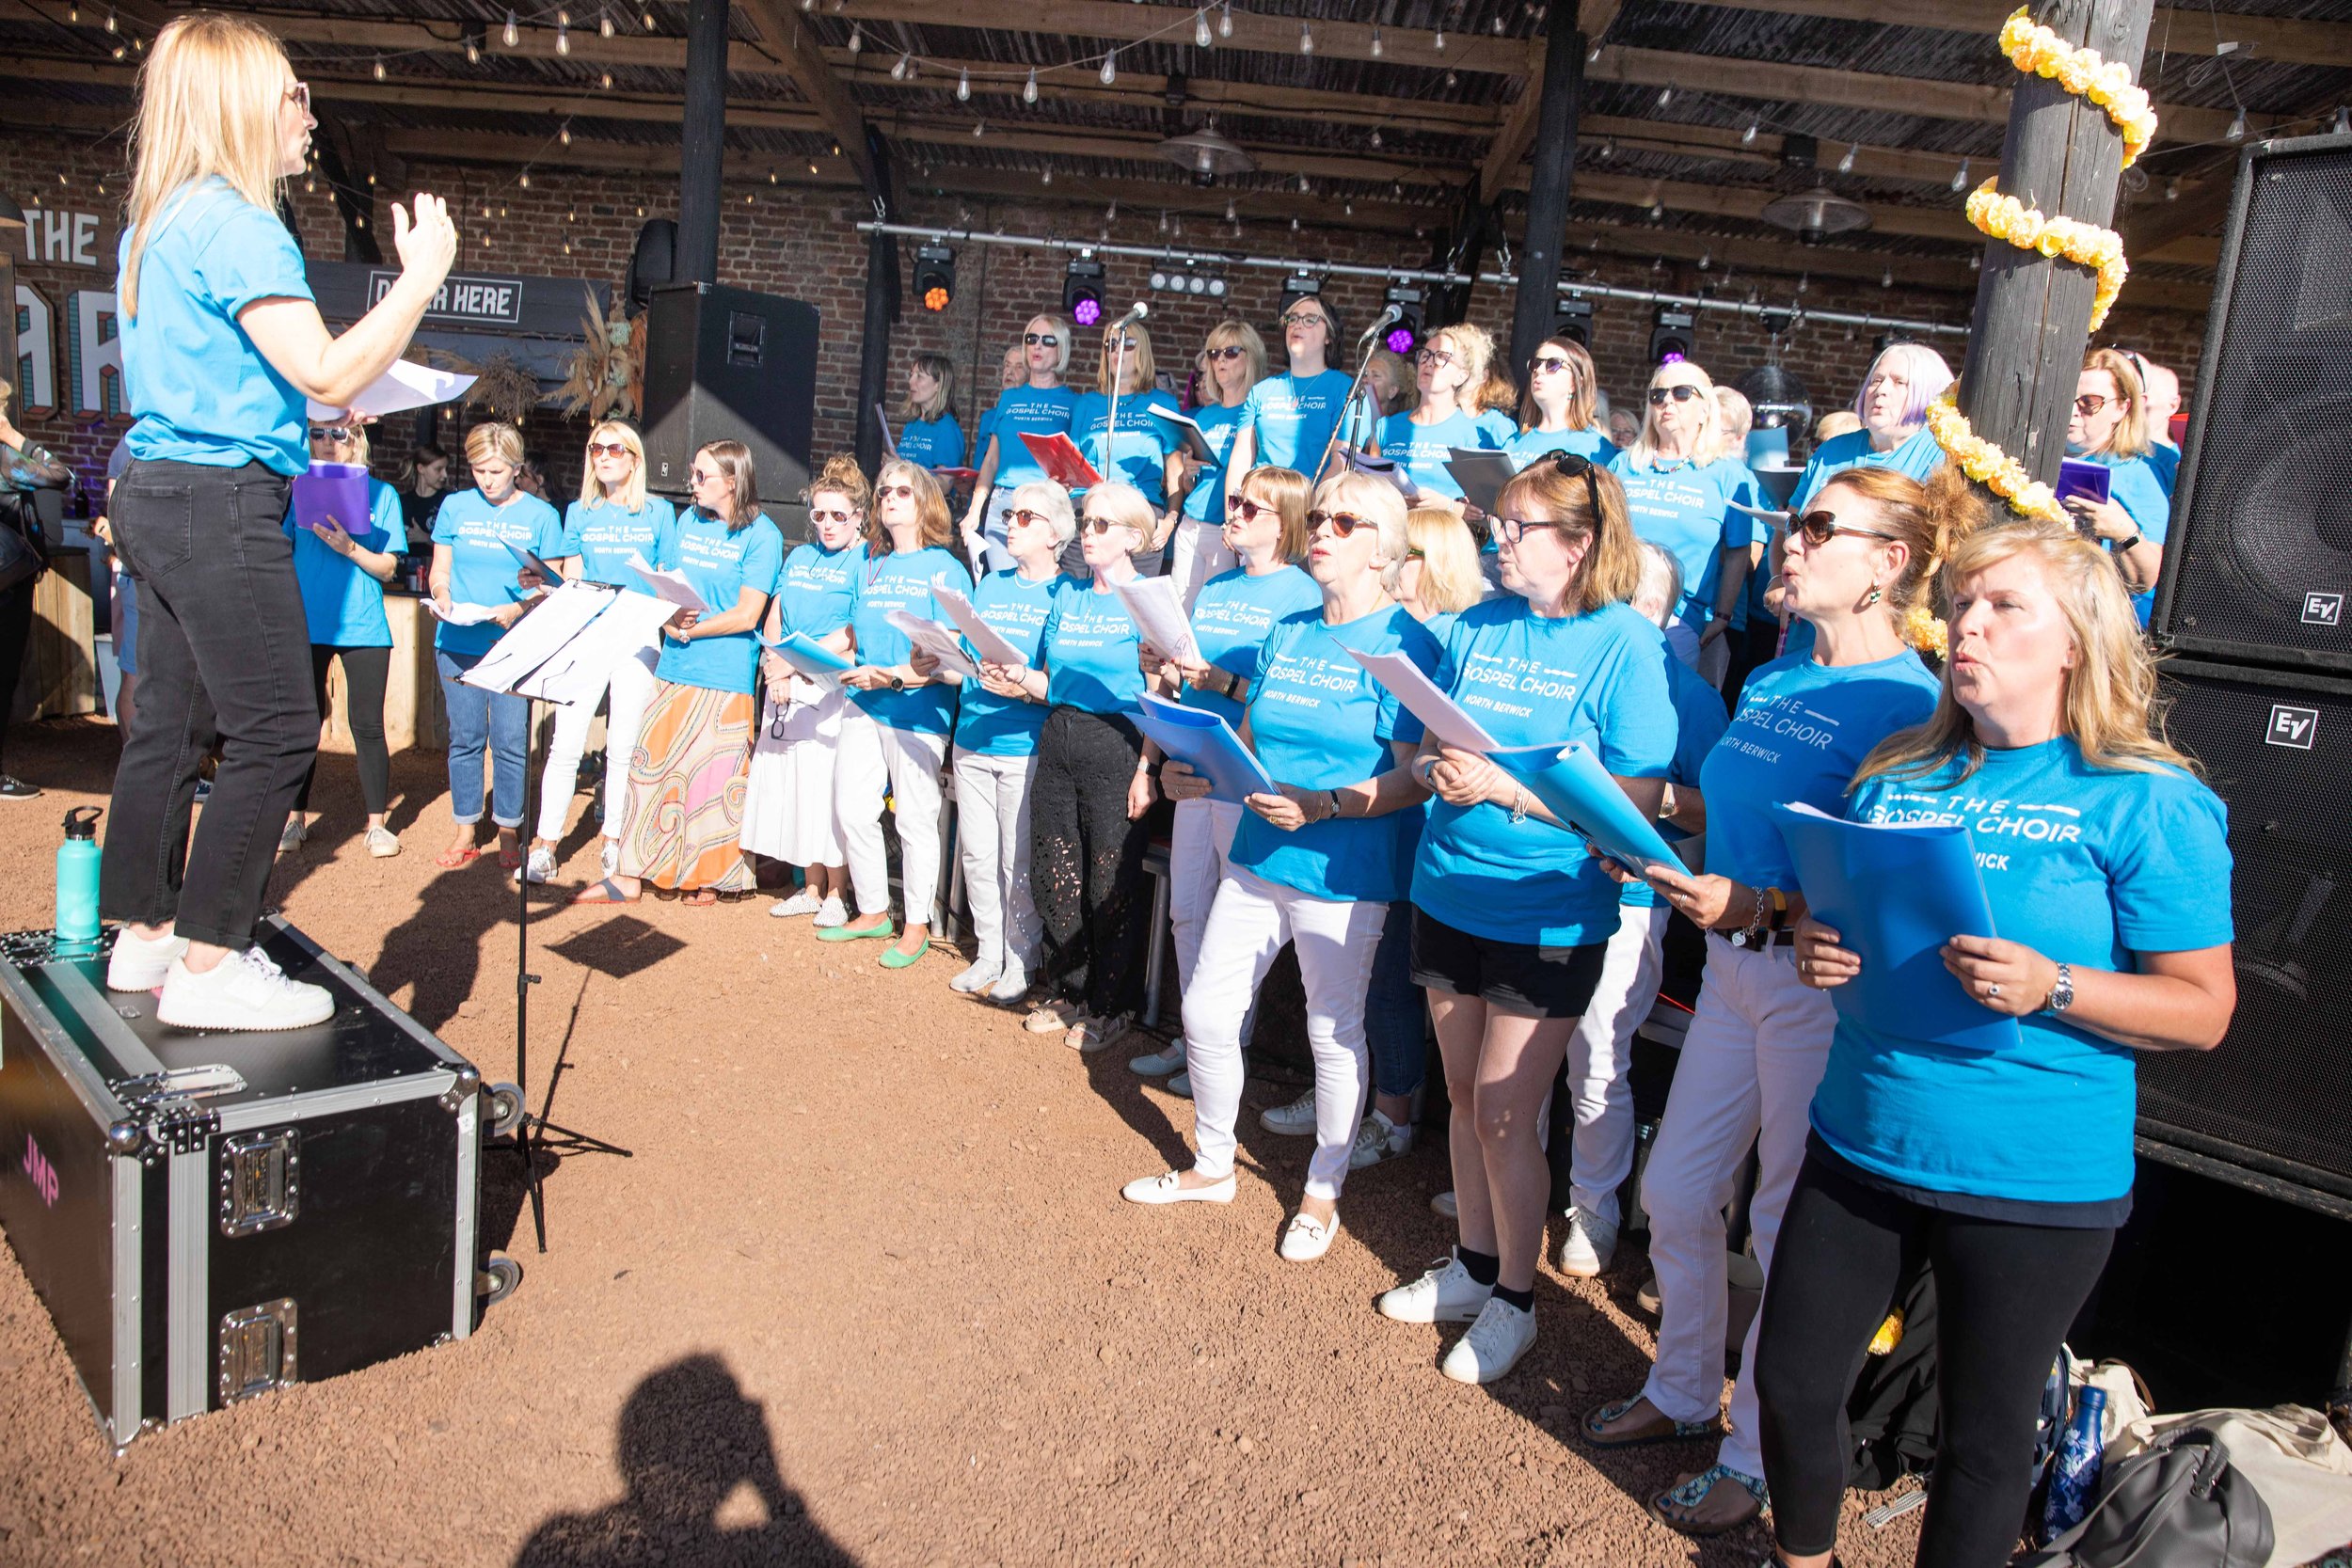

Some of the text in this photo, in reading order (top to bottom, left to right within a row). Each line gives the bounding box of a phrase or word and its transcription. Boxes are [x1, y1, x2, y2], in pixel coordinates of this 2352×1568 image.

[23, 209, 100, 266] THE
[453, 284, 512, 316] HERE
[1298, 402, 1327, 410] CHOIR
[1041, 408, 1071, 420] CHOIR
[1089, 420, 1125, 431] GOSEL
[1382, 448, 1419, 458] GOSPEL
[1649, 479, 1677, 490] THE
[1627, 487, 1706, 509] OSPEL CHOIR
[1648, 508, 1679, 520] BERWICK
[485, 520, 508, 531] THE
[609, 526, 629, 534] THE
[458, 527, 532, 542] GOSPEL CHOIR
[581, 533, 655, 543] GOSPEL CHOIR
[704, 537, 723, 547] THE
[710, 547, 740, 562] CHOIR
[884, 575, 904, 584] THE
[895, 585, 929, 597] CHOIR
[1010, 603, 1032, 612] THE
[1225, 600, 1248, 611] THE
[980, 610, 1045, 626] GOSPEL CHO
[1083, 614, 1104, 624] THE
[1232, 611, 1271, 629] CHOIR
[1059, 621, 1130, 635] OSPEL CHOIR
[1057, 639, 1078, 647] NORTH
[1299, 656, 1328, 672] THE
[1507, 657, 1542, 675] THE
[1266, 665, 1358, 693] OSPEL CHOIR
[1519, 676, 1577, 702] CHOIR
[1263, 689, 1322, 707] NORTH BERWICK
[1768, 694, 1804, 715] THE
[1463, 693, 1534, 719] NORTH BERWICK
[1734, 708, 1834, 751] SPEL CHOIR
[2275, 711, 2311, 740] EV
[1740, 741, 1782, 765] BERWICK
[1947, 796, 2010, 815] THE
[1976, 816, 2082, 844] CHOIR
[23, 1132, 59, 1209] JMP
